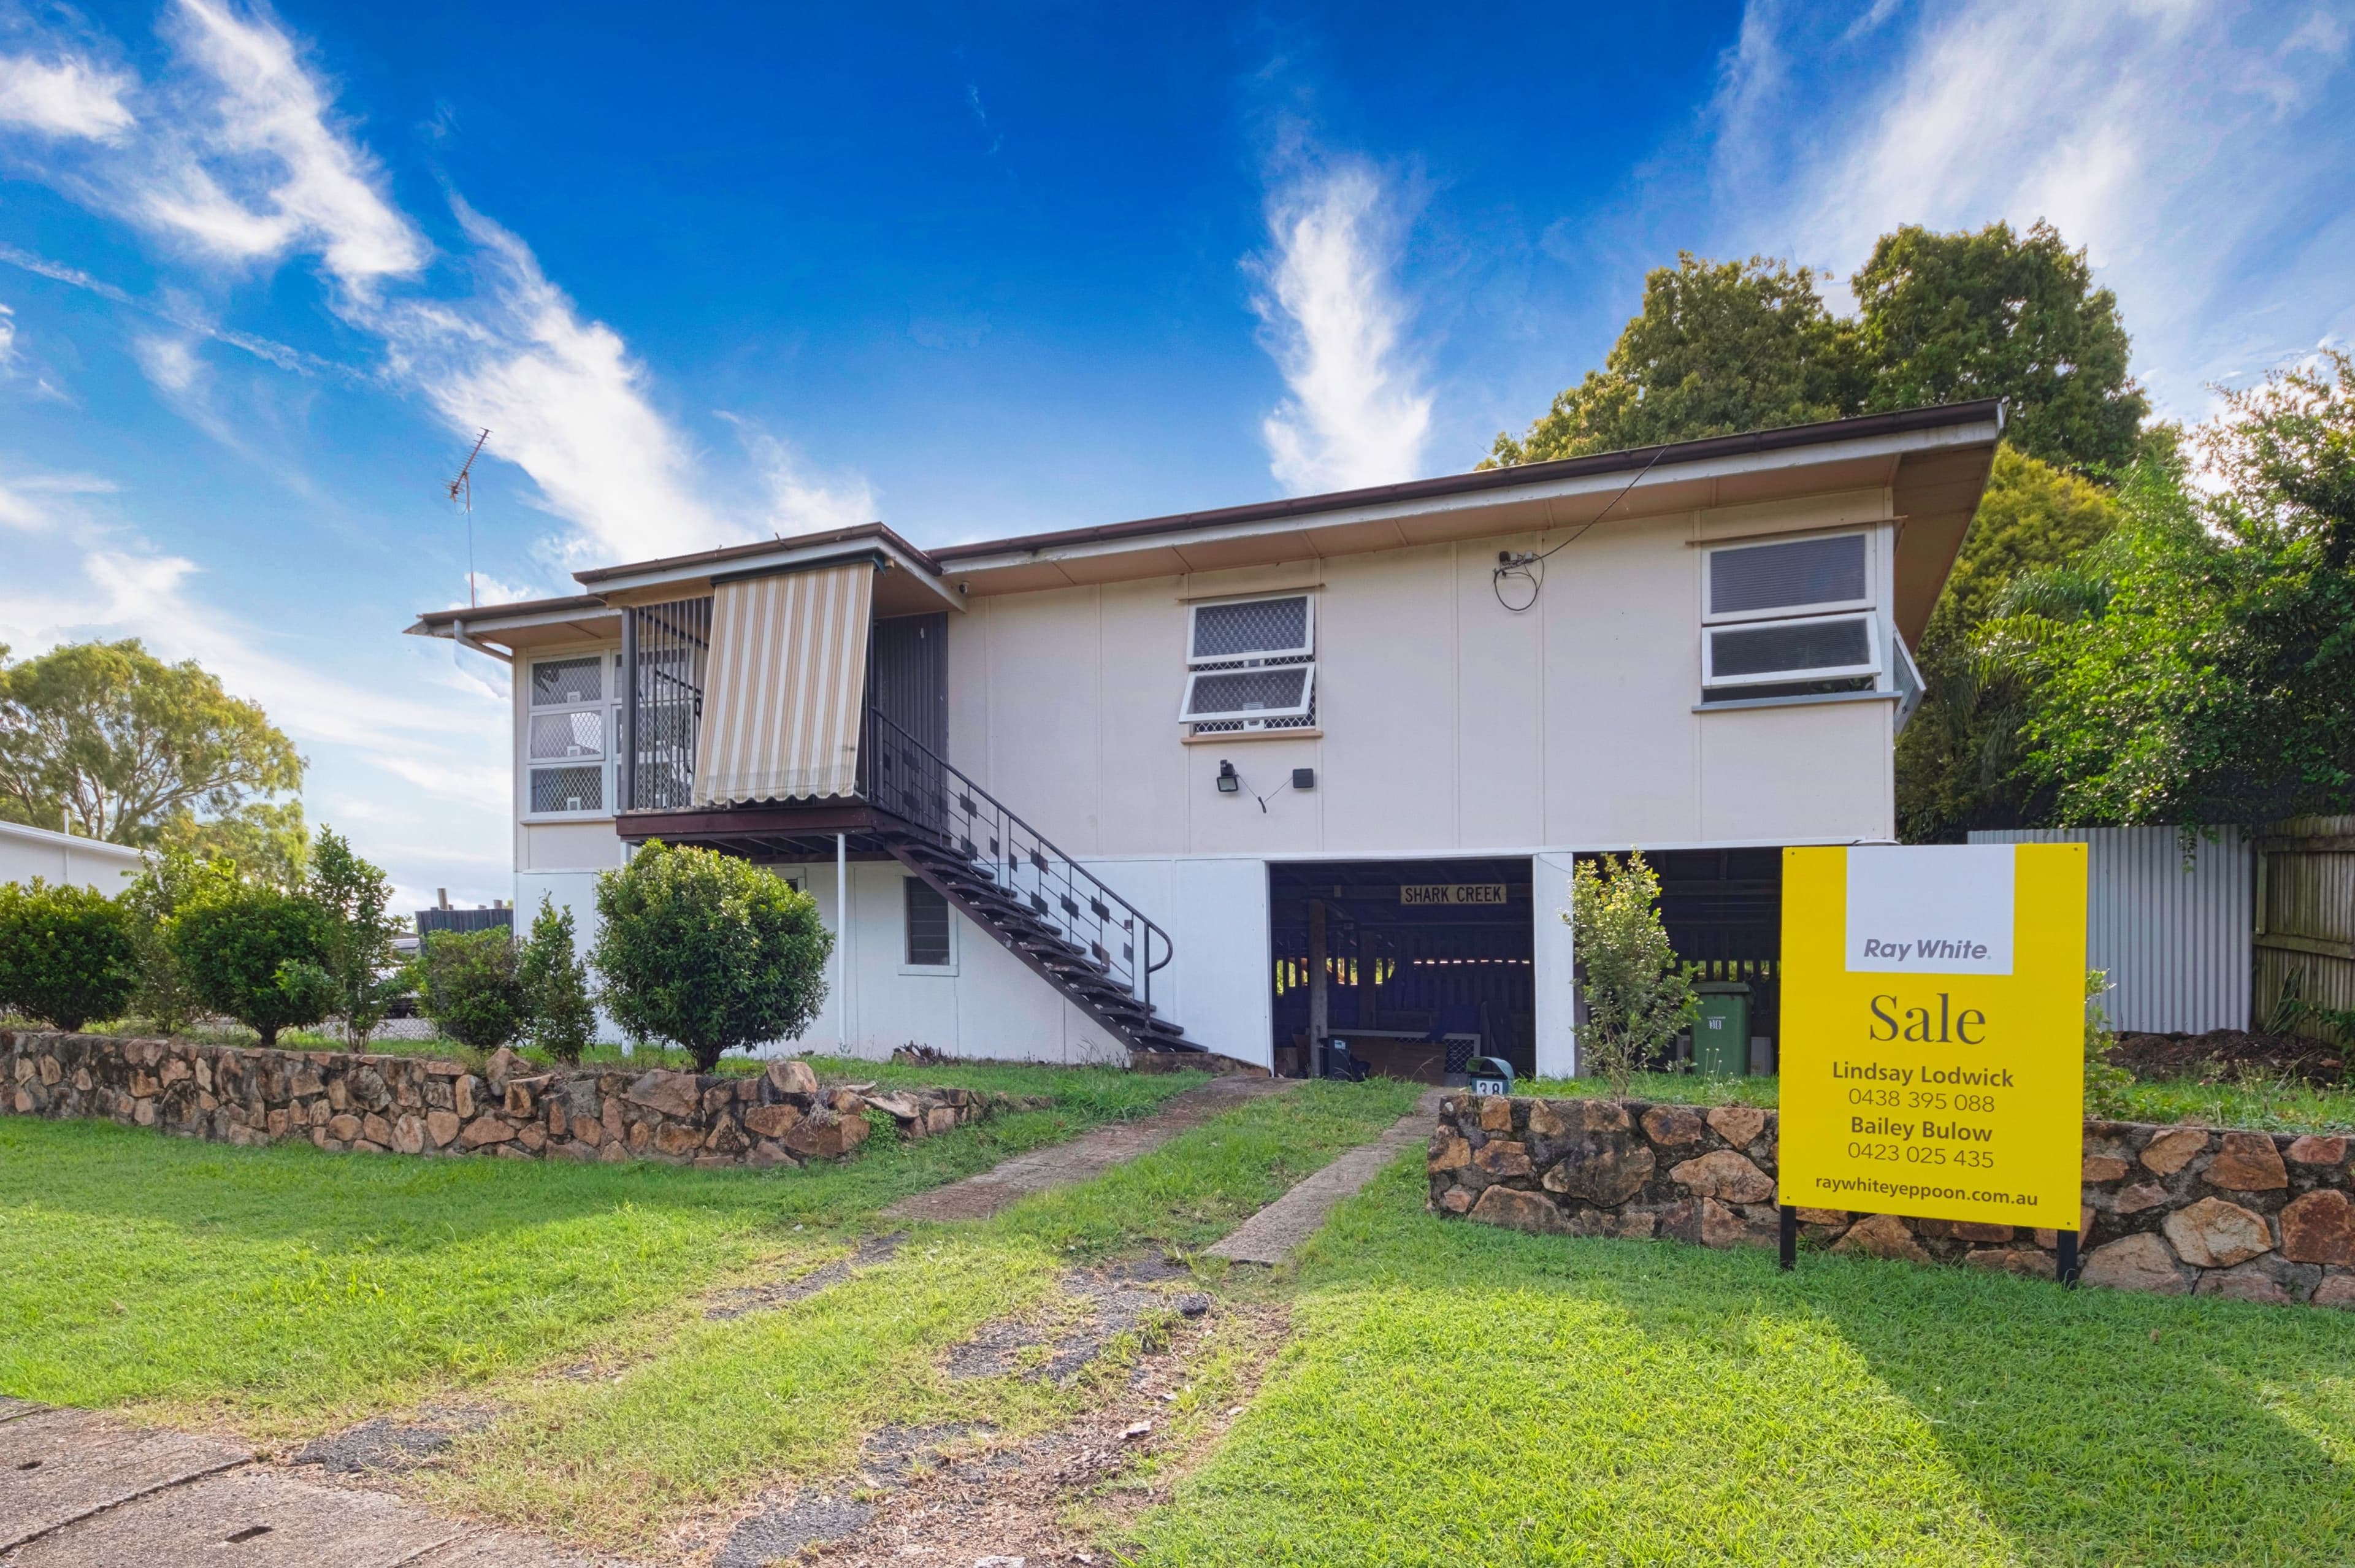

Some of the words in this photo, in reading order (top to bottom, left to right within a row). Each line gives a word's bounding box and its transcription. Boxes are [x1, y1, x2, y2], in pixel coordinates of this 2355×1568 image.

[1405, 887, 1449, 903] SHARK
[1457, 886, 1502, 903] CREEK
[1864, 938, 1912, 962] Ray
[1917, 939, 1988, 959] White
[1870, 993, 1986, 1045] Sale
[1833, 1061, 1913, 1086] Lindsay
[1921, 1066, 2014, 1088] Lodwick
[1480, 1082, 1499, 1095] 38
[1848, 1088, 1900, 1107] 0438
[1908, 1092, 1947, 1109] 395
[1955, 1094, 1994, 1112] 088
[1851, 1116, 1915, 1141] Bailey
[1923, 1121, 1993, 1142] Bulow
[1848, 1142, 1899, 1161] 0423
[1907, 1146, 1946, 1165] 025
[1953, 1150, 1994, 1168] 435
[1816, 1177, 2038, 1206] raywhiteyeppoon.com.au
